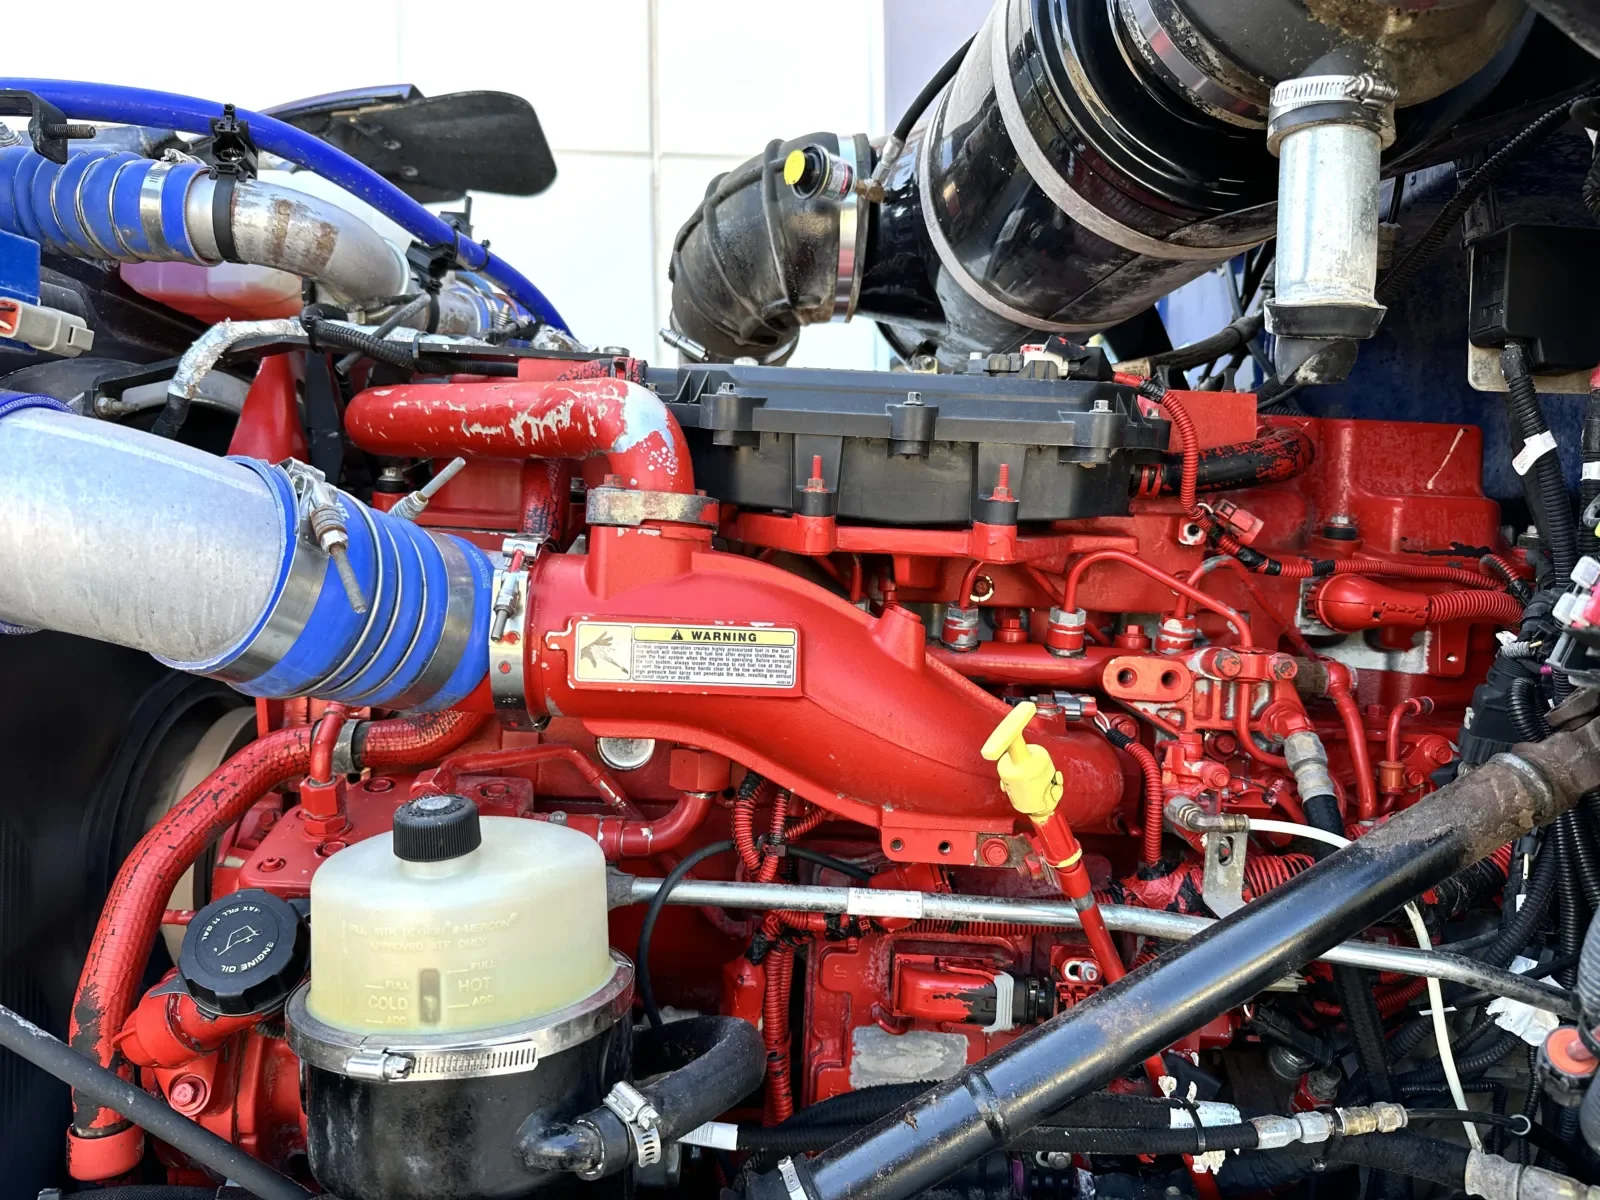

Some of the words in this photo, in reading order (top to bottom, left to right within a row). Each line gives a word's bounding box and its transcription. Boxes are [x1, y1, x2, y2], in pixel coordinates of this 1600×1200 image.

[691, 631, 757, 642] WARNING
[222, 906, 239, 916] FILL
[242, 905, 261, 913] MAX
[201, 925, 213, 941] GAL
[368, 941, 424, 952] APPROVED
[431, 939, 452, 951] ATF
[457, 936, 488, 949] ONLY
[240, 941, 274, 972] ENGINE
[221, 964, 237, 973] OIL
[470, 958, 497, 971] FULL
[385, 979, 410, 991] FULL
[457, 976, 492, 993] HOT
[368, 995, 409, 1011] COLD
[471, 994, 495, 1007] ADD
[385, 1015, 408, 1025] ADD
